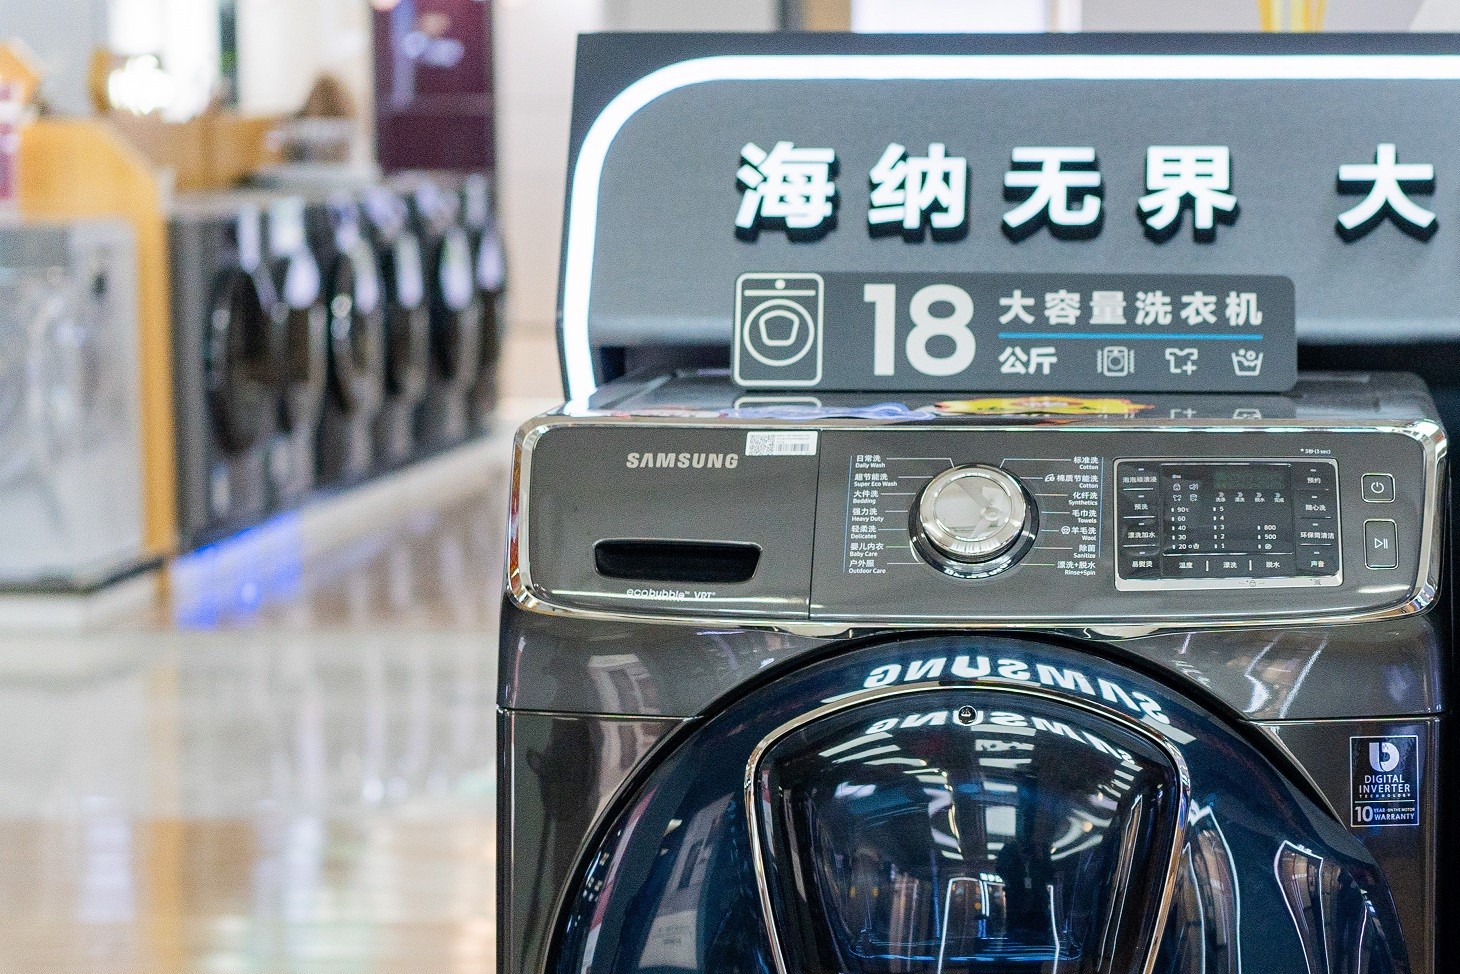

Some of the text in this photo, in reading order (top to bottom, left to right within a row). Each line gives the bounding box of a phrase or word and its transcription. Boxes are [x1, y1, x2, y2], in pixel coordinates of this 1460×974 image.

[735, 140, 1238, 232] 海纳无界
[999, 290, 1263, 327] 大容量洗衣机
[864, 283, 976, 376] 18
[999, 346, 1058, 375] 公斤
[626, 452, 739, 469] SAMSUNG
[856, 454, 881, 462] 日常洗
[1074, 456, 1098, 464] 标准洗
[854, 473, 888, 481] 超节能洗
[853, 490, 878, 498] 大件洗
[1072, 492, 1098, 500] 化纤洗
[852, 508, 878, 516] 强力洗
[1072, 510, 1098, 518] 毛巾洗
[851, 524, 877, 533] 轻柔洗
[1071, 526, 1097, 534] 羊毛洗
[850, 542, 884, 550] 婴儿内衣
[849, 560, 874, 568] 户外服
[1364, 774, 1405, 784] DIGITAL
[1359, 784, 1411, 794] INVERTER
[1354, 806, 1374, 822] 10
